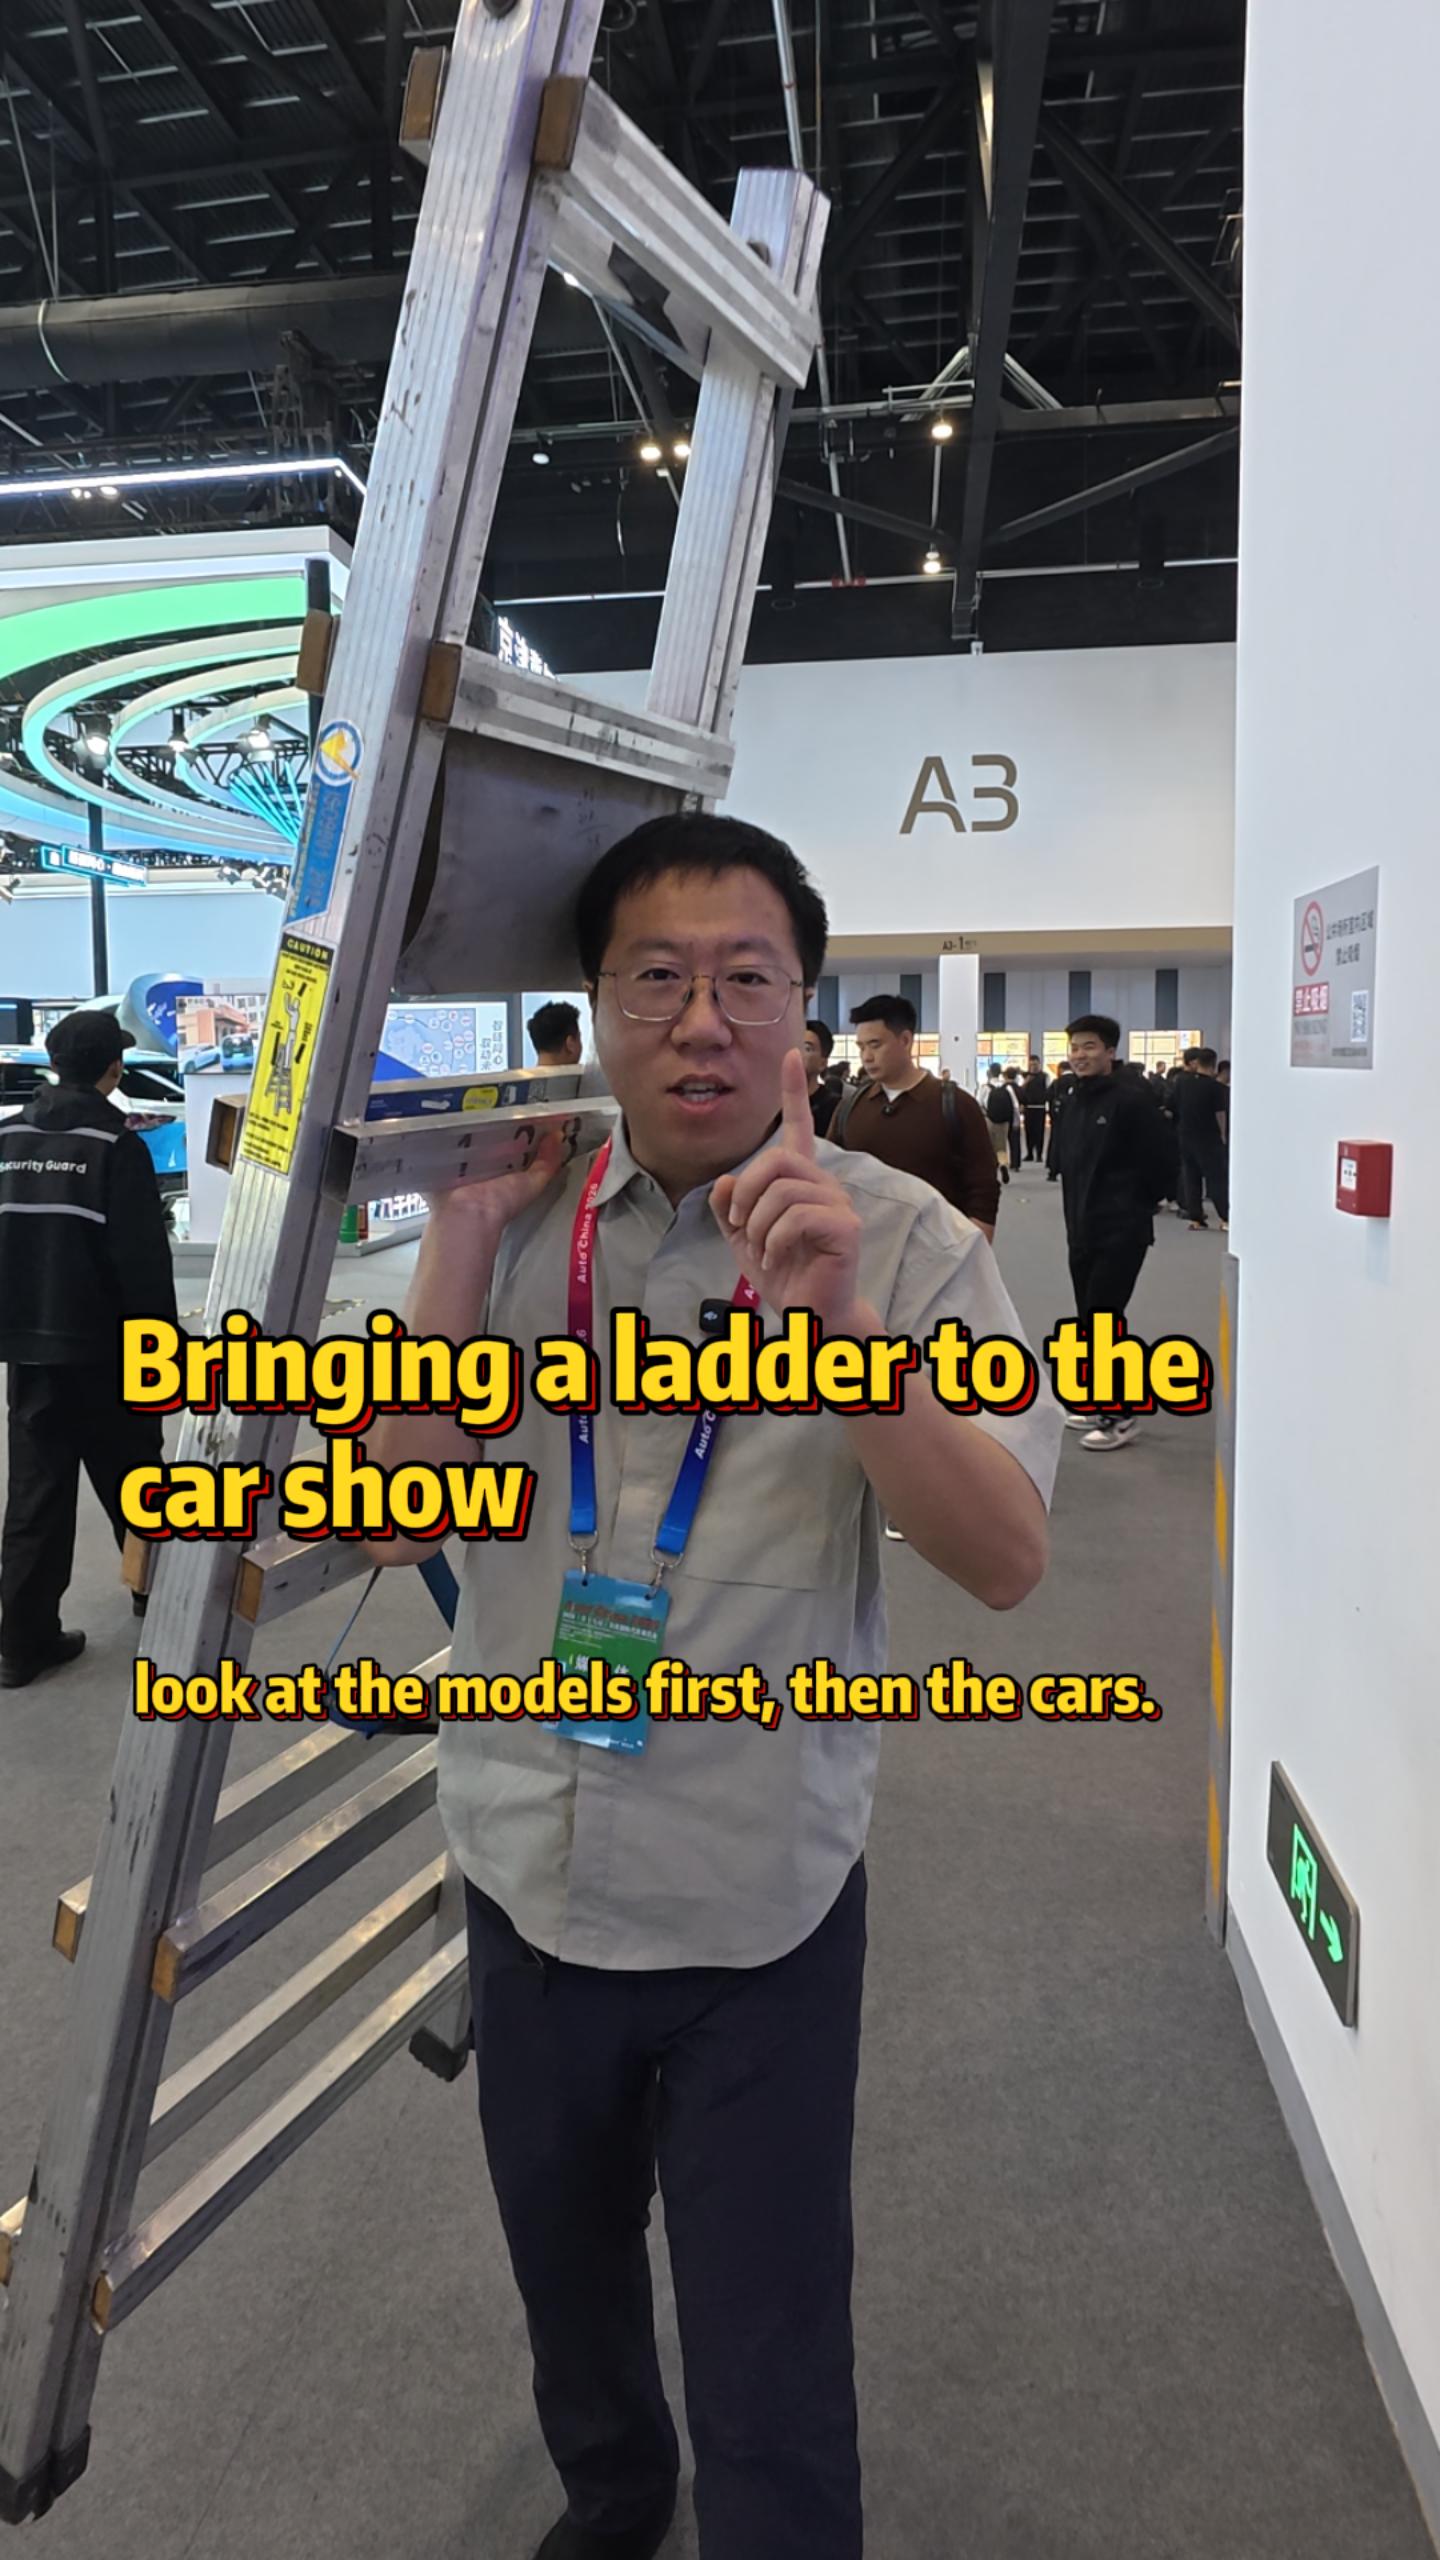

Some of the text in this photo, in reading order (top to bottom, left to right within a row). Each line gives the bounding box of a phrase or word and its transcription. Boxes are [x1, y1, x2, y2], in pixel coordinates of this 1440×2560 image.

[899, 754, 1019, 834] A3
[287, 937, 330, 961] CAUTION
[45, 1160, 87, 1174] Guard
[577, 1213, 593, 1250] China
[576, 1251, 589, 1284] Auto
[694, 1424, 713, 1460] Auto
